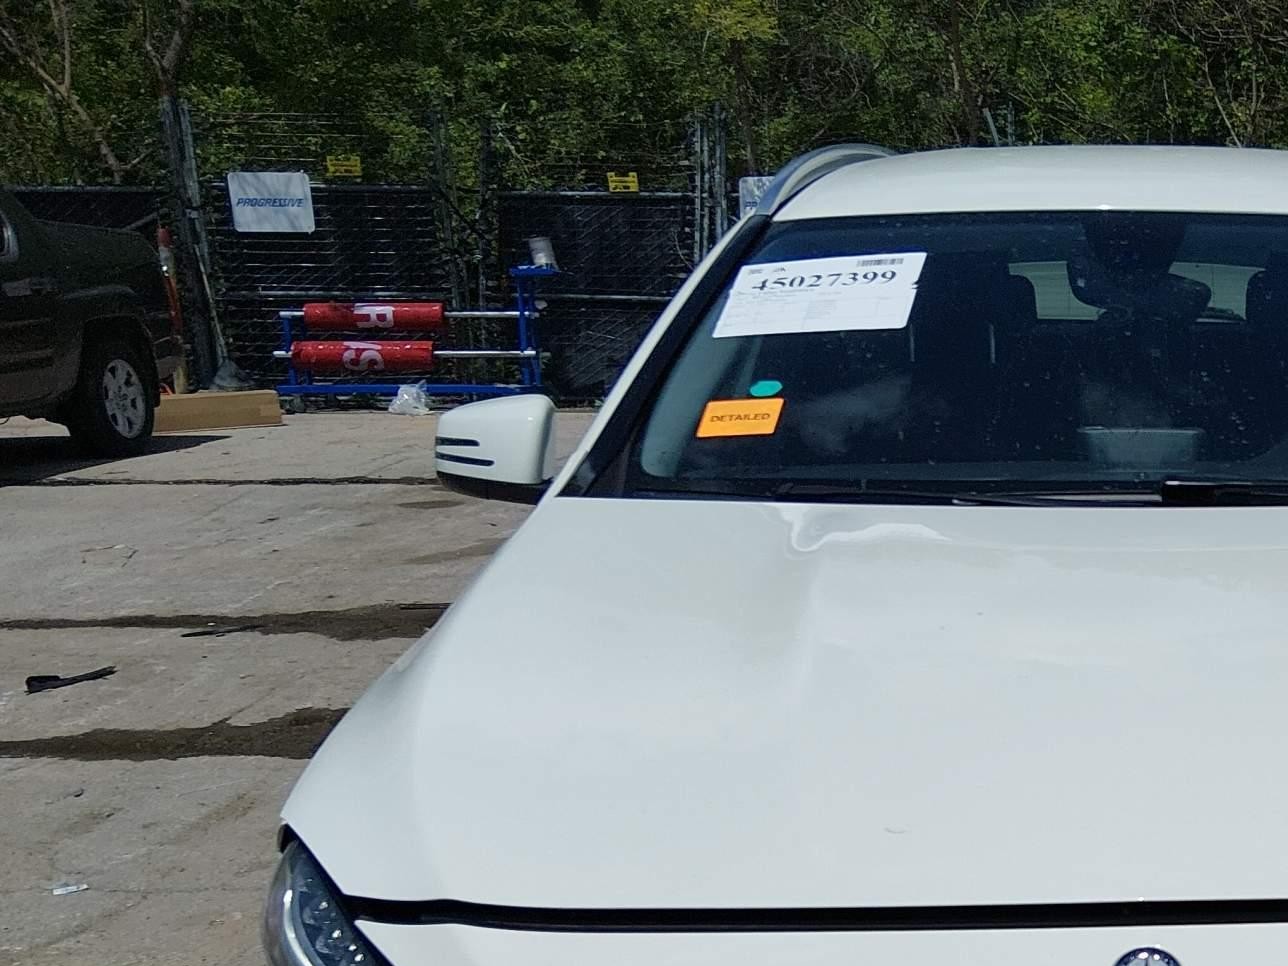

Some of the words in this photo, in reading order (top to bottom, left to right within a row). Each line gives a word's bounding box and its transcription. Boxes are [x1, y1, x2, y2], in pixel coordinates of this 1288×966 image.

[236, 197, 304, 208] PROGRESSIVE
[752, 269, 897, 291] 45027399
[710, 413, 770, 423] DETAILED
